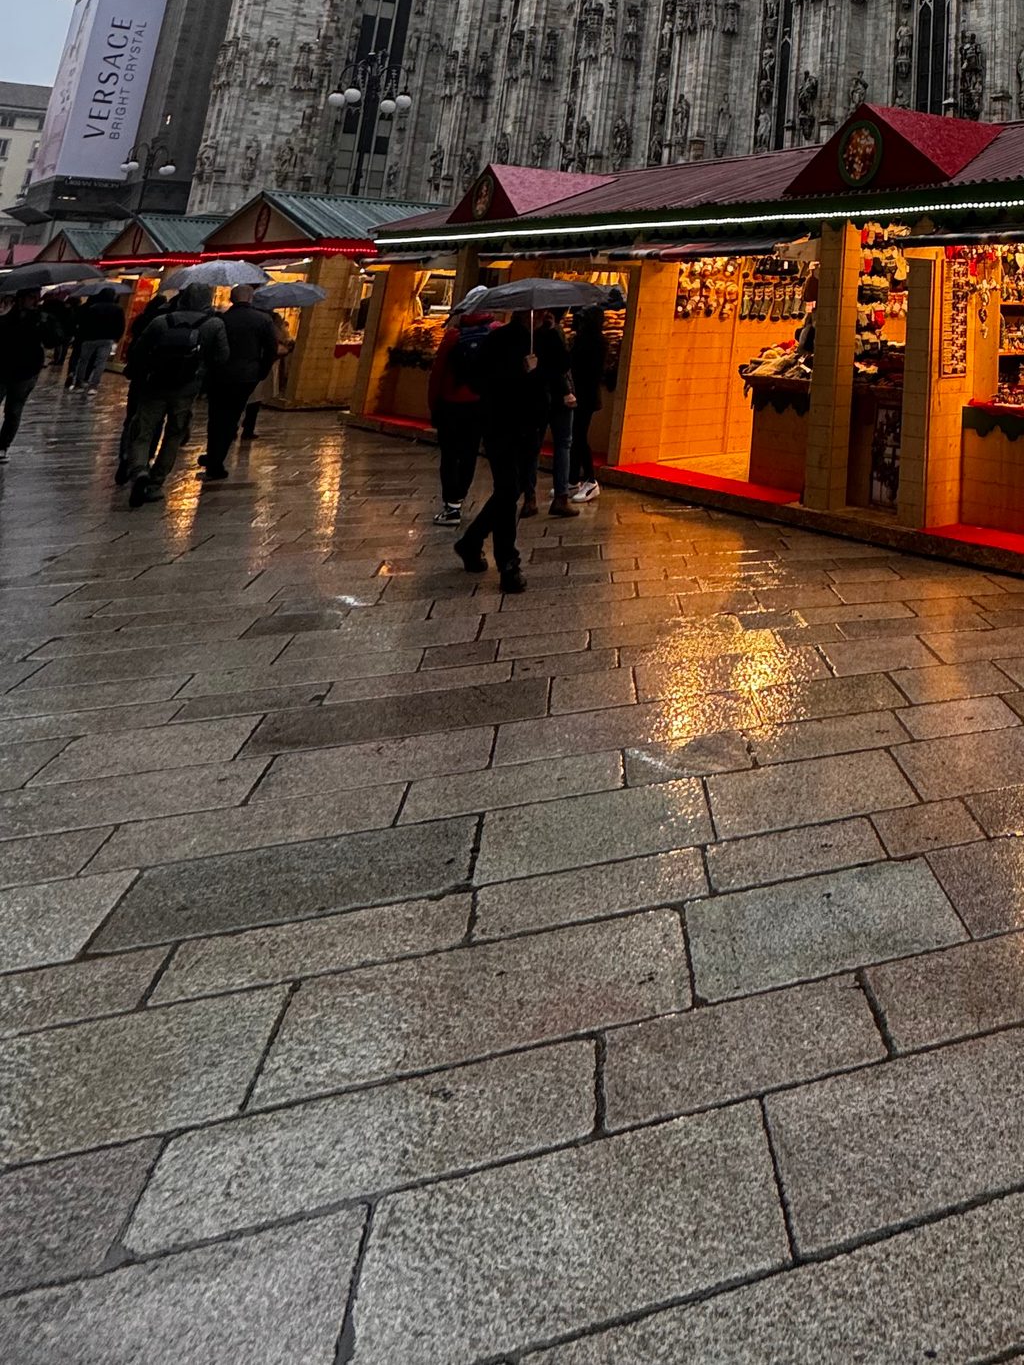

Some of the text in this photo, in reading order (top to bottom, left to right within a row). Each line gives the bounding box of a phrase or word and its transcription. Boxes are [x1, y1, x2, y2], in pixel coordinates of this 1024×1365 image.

[83, 17, 133, 138] VERSACE
[109, 22, 147, 140] BRIGHT CRYSTAL
